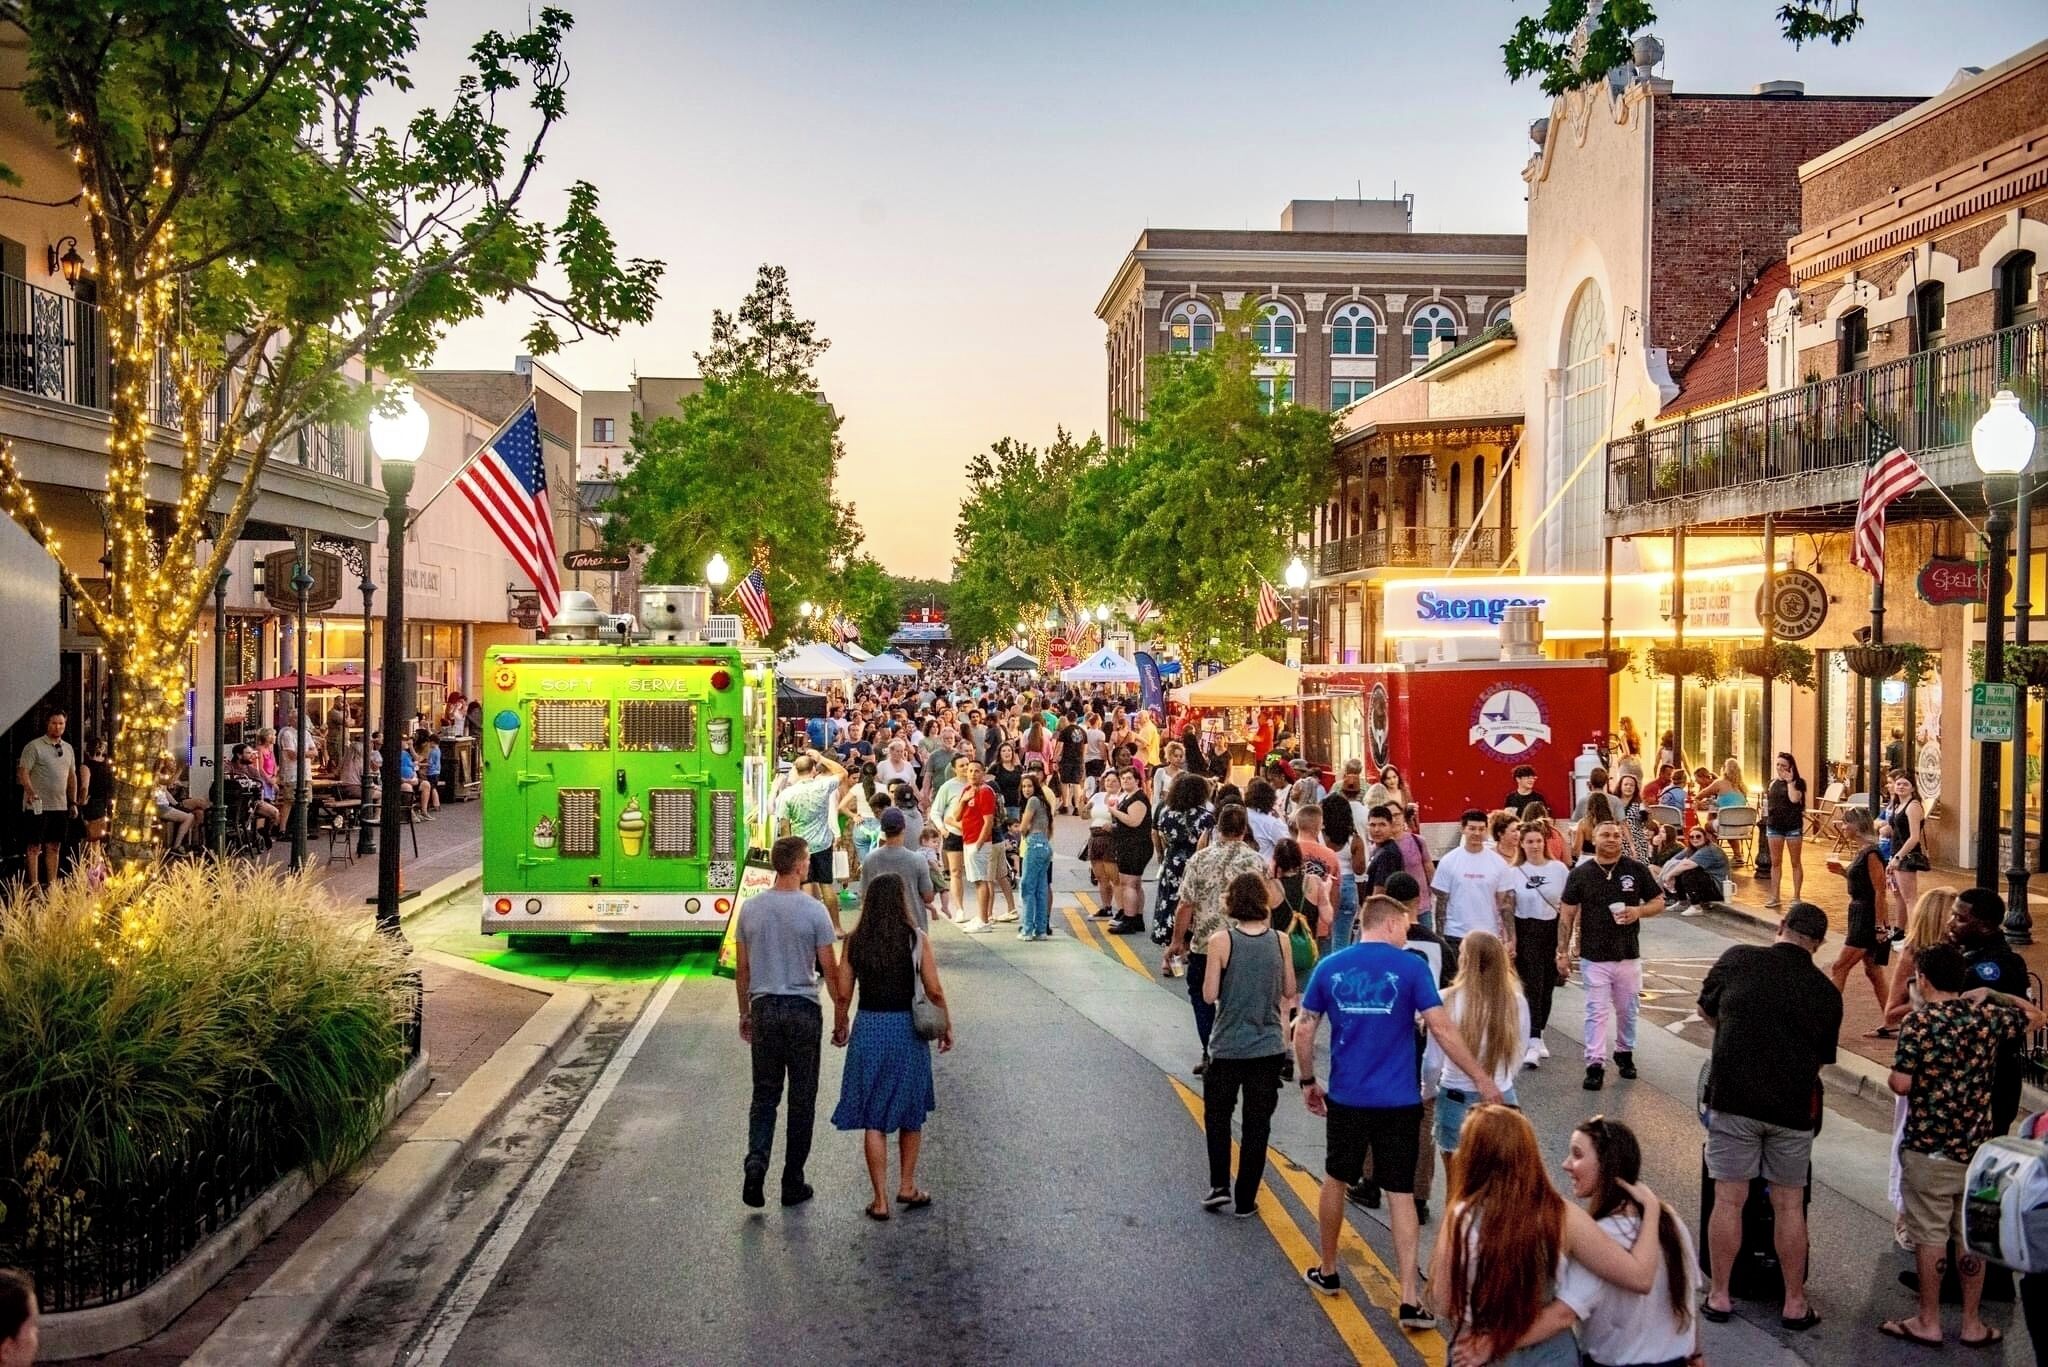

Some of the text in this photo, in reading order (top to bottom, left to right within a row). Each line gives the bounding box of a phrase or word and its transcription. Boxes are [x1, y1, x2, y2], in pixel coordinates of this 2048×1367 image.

[1050, 643, 1067, 652] STOP
[541, 678, 688, 693] SOFT SERVE
[1975, 688, 1984, 701] 2
